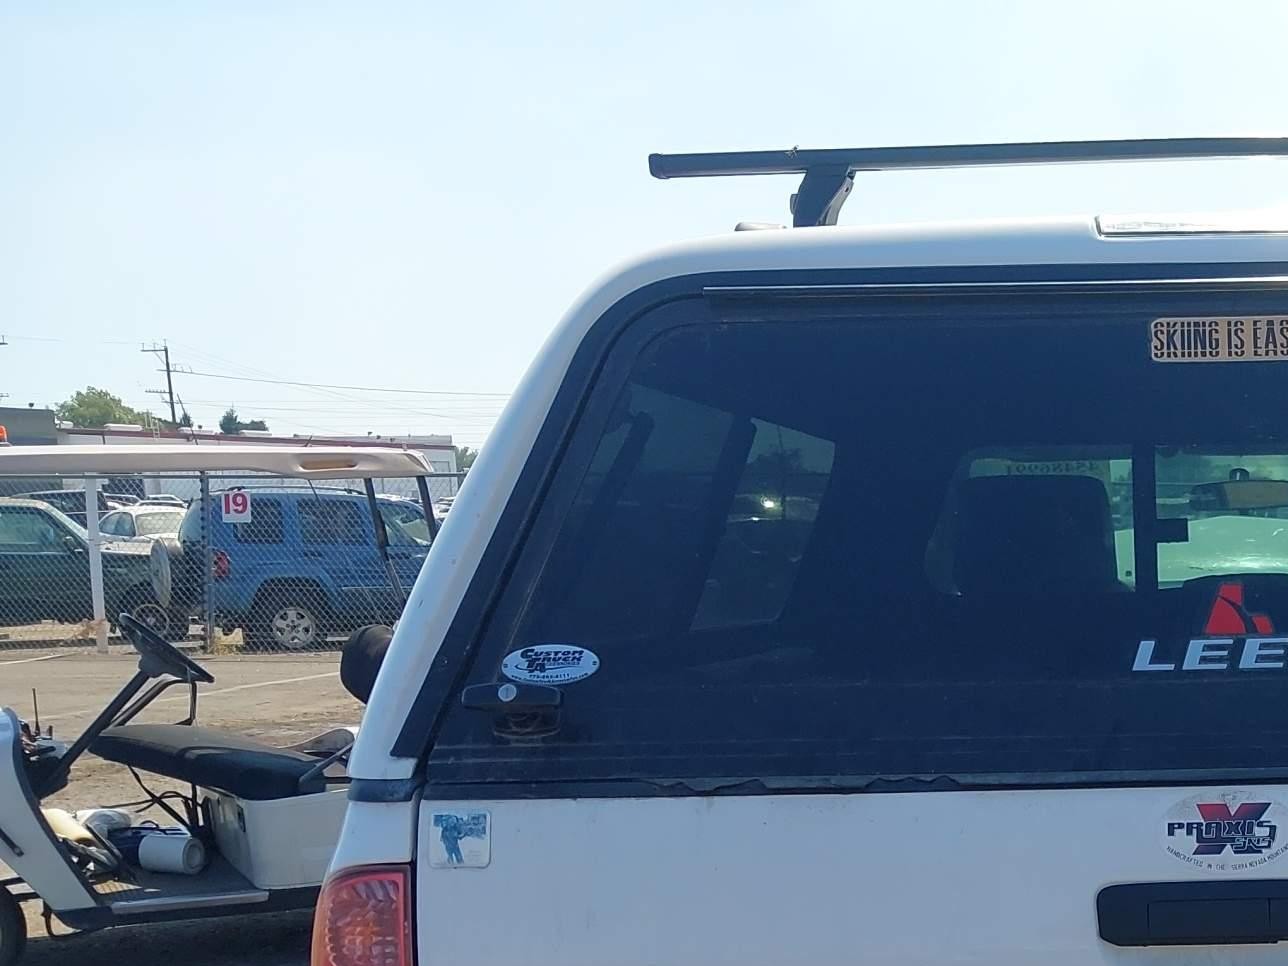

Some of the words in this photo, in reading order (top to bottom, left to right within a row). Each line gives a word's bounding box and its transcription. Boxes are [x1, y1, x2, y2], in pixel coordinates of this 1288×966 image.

[1153, 320, 1219, 358] SKIING
[1226, 320, 1245, 357] IS
[224, 493, 248, 515] 19
[1167, 820, 1277, 844] PRAXIS
